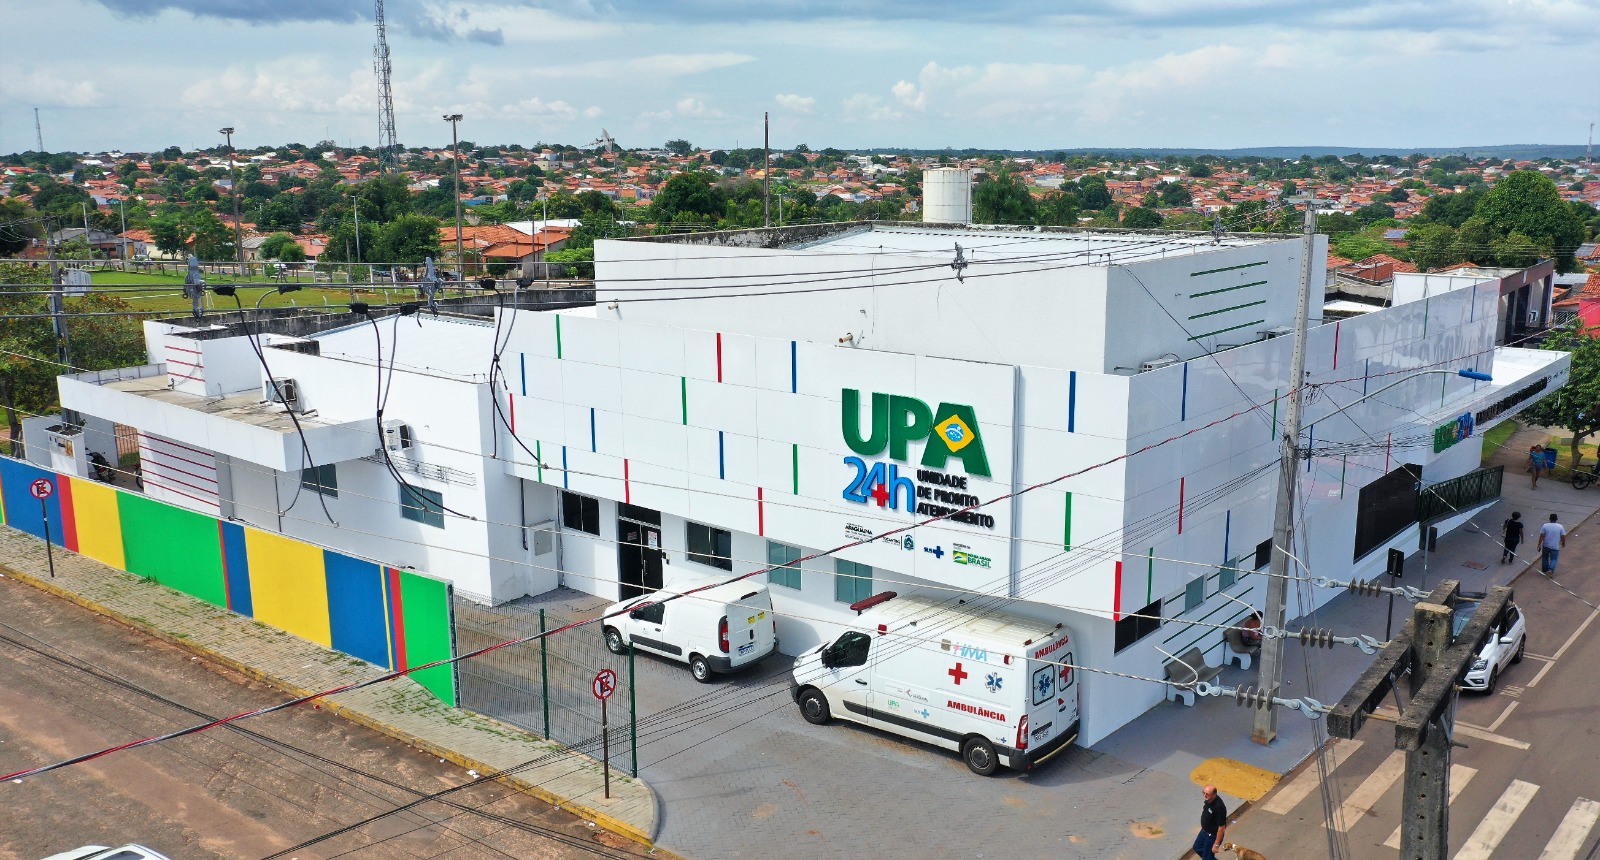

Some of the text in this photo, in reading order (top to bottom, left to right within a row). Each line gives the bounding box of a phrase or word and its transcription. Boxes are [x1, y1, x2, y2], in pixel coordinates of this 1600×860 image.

[842, 388, 992, 477] UPA
[843, 456, 916, 513] 24h
[916, 469, 967, 490] UNIDADE
[917, 485, 980, 508] DE PRONTO
[916, 502, 995, 529] ATENDIMENTO
[967, 557, 992, 569] BRASIL
[1034, 635, 1069, 660] AMBULÂNCIA
[946, 700, 1006, 722] AMBULÂNCIA
